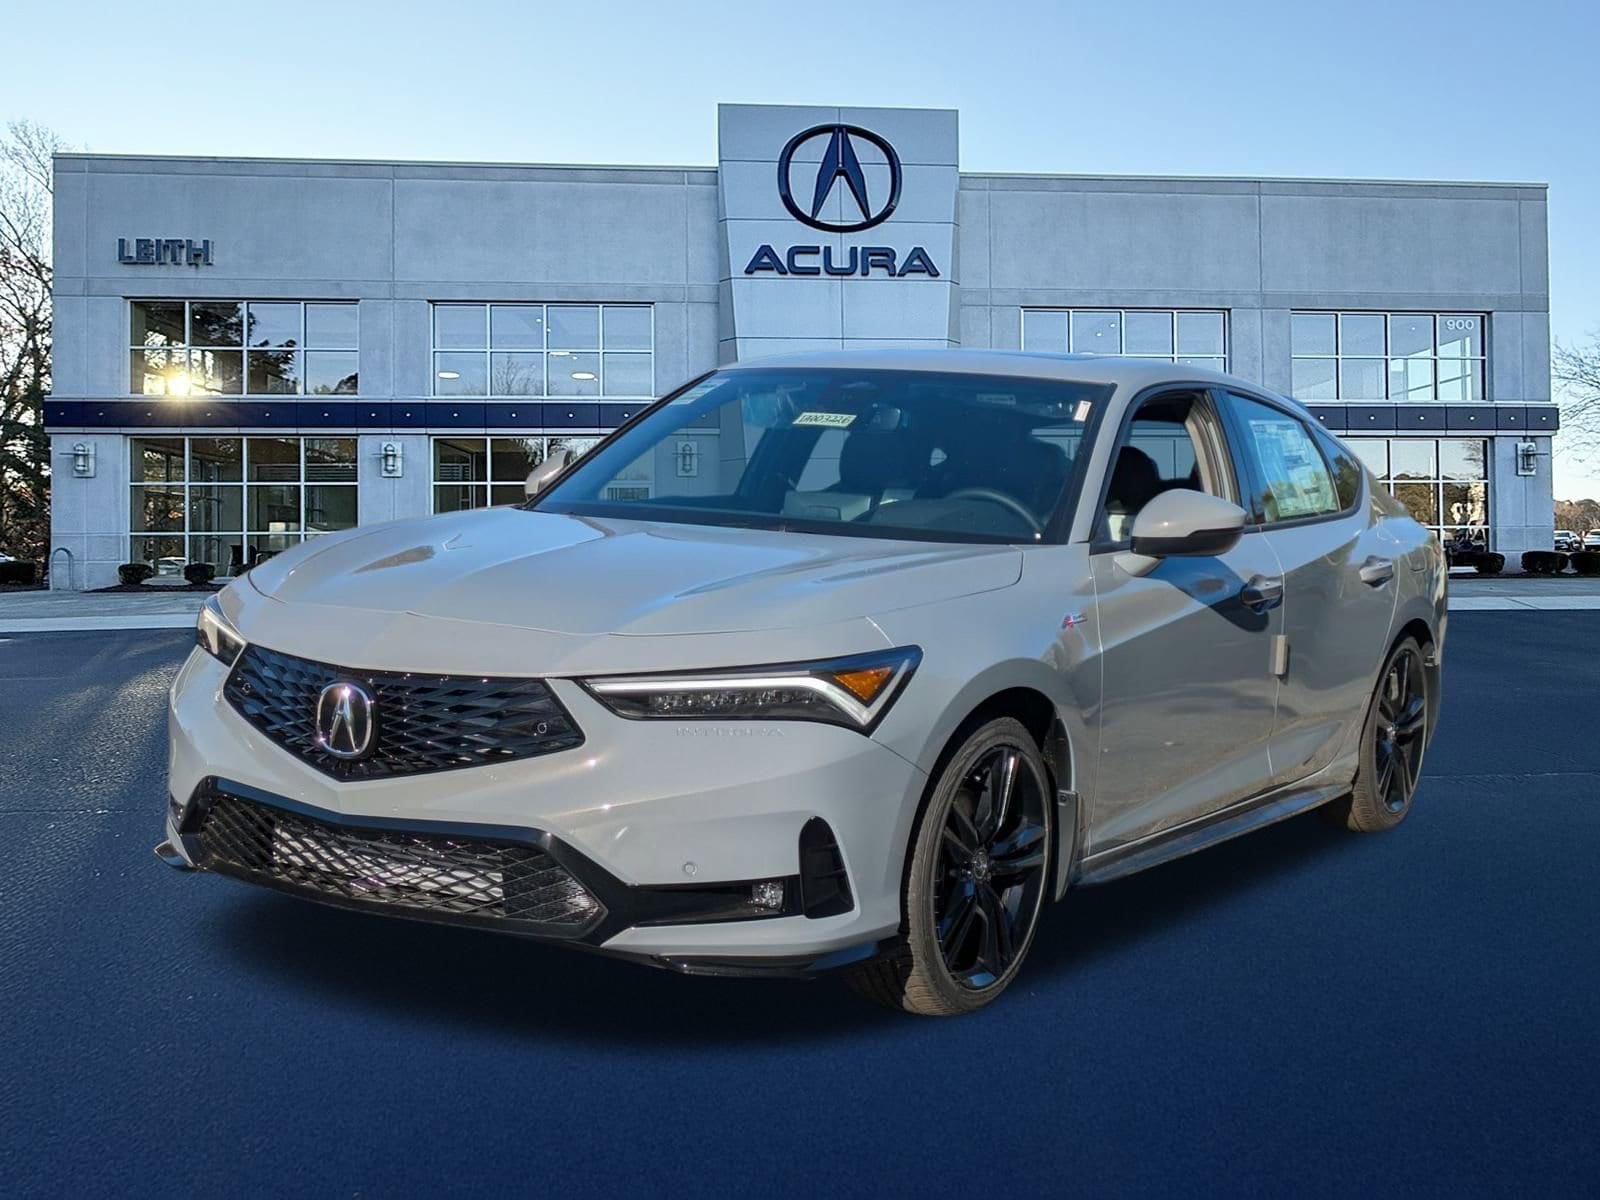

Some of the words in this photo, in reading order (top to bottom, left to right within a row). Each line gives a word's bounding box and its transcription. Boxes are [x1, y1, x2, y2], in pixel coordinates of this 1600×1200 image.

[118, 238, 211, 264] LEITH
[744, 245, 940, 277] ACURA
[1446, 319, 1474, 330] 900
